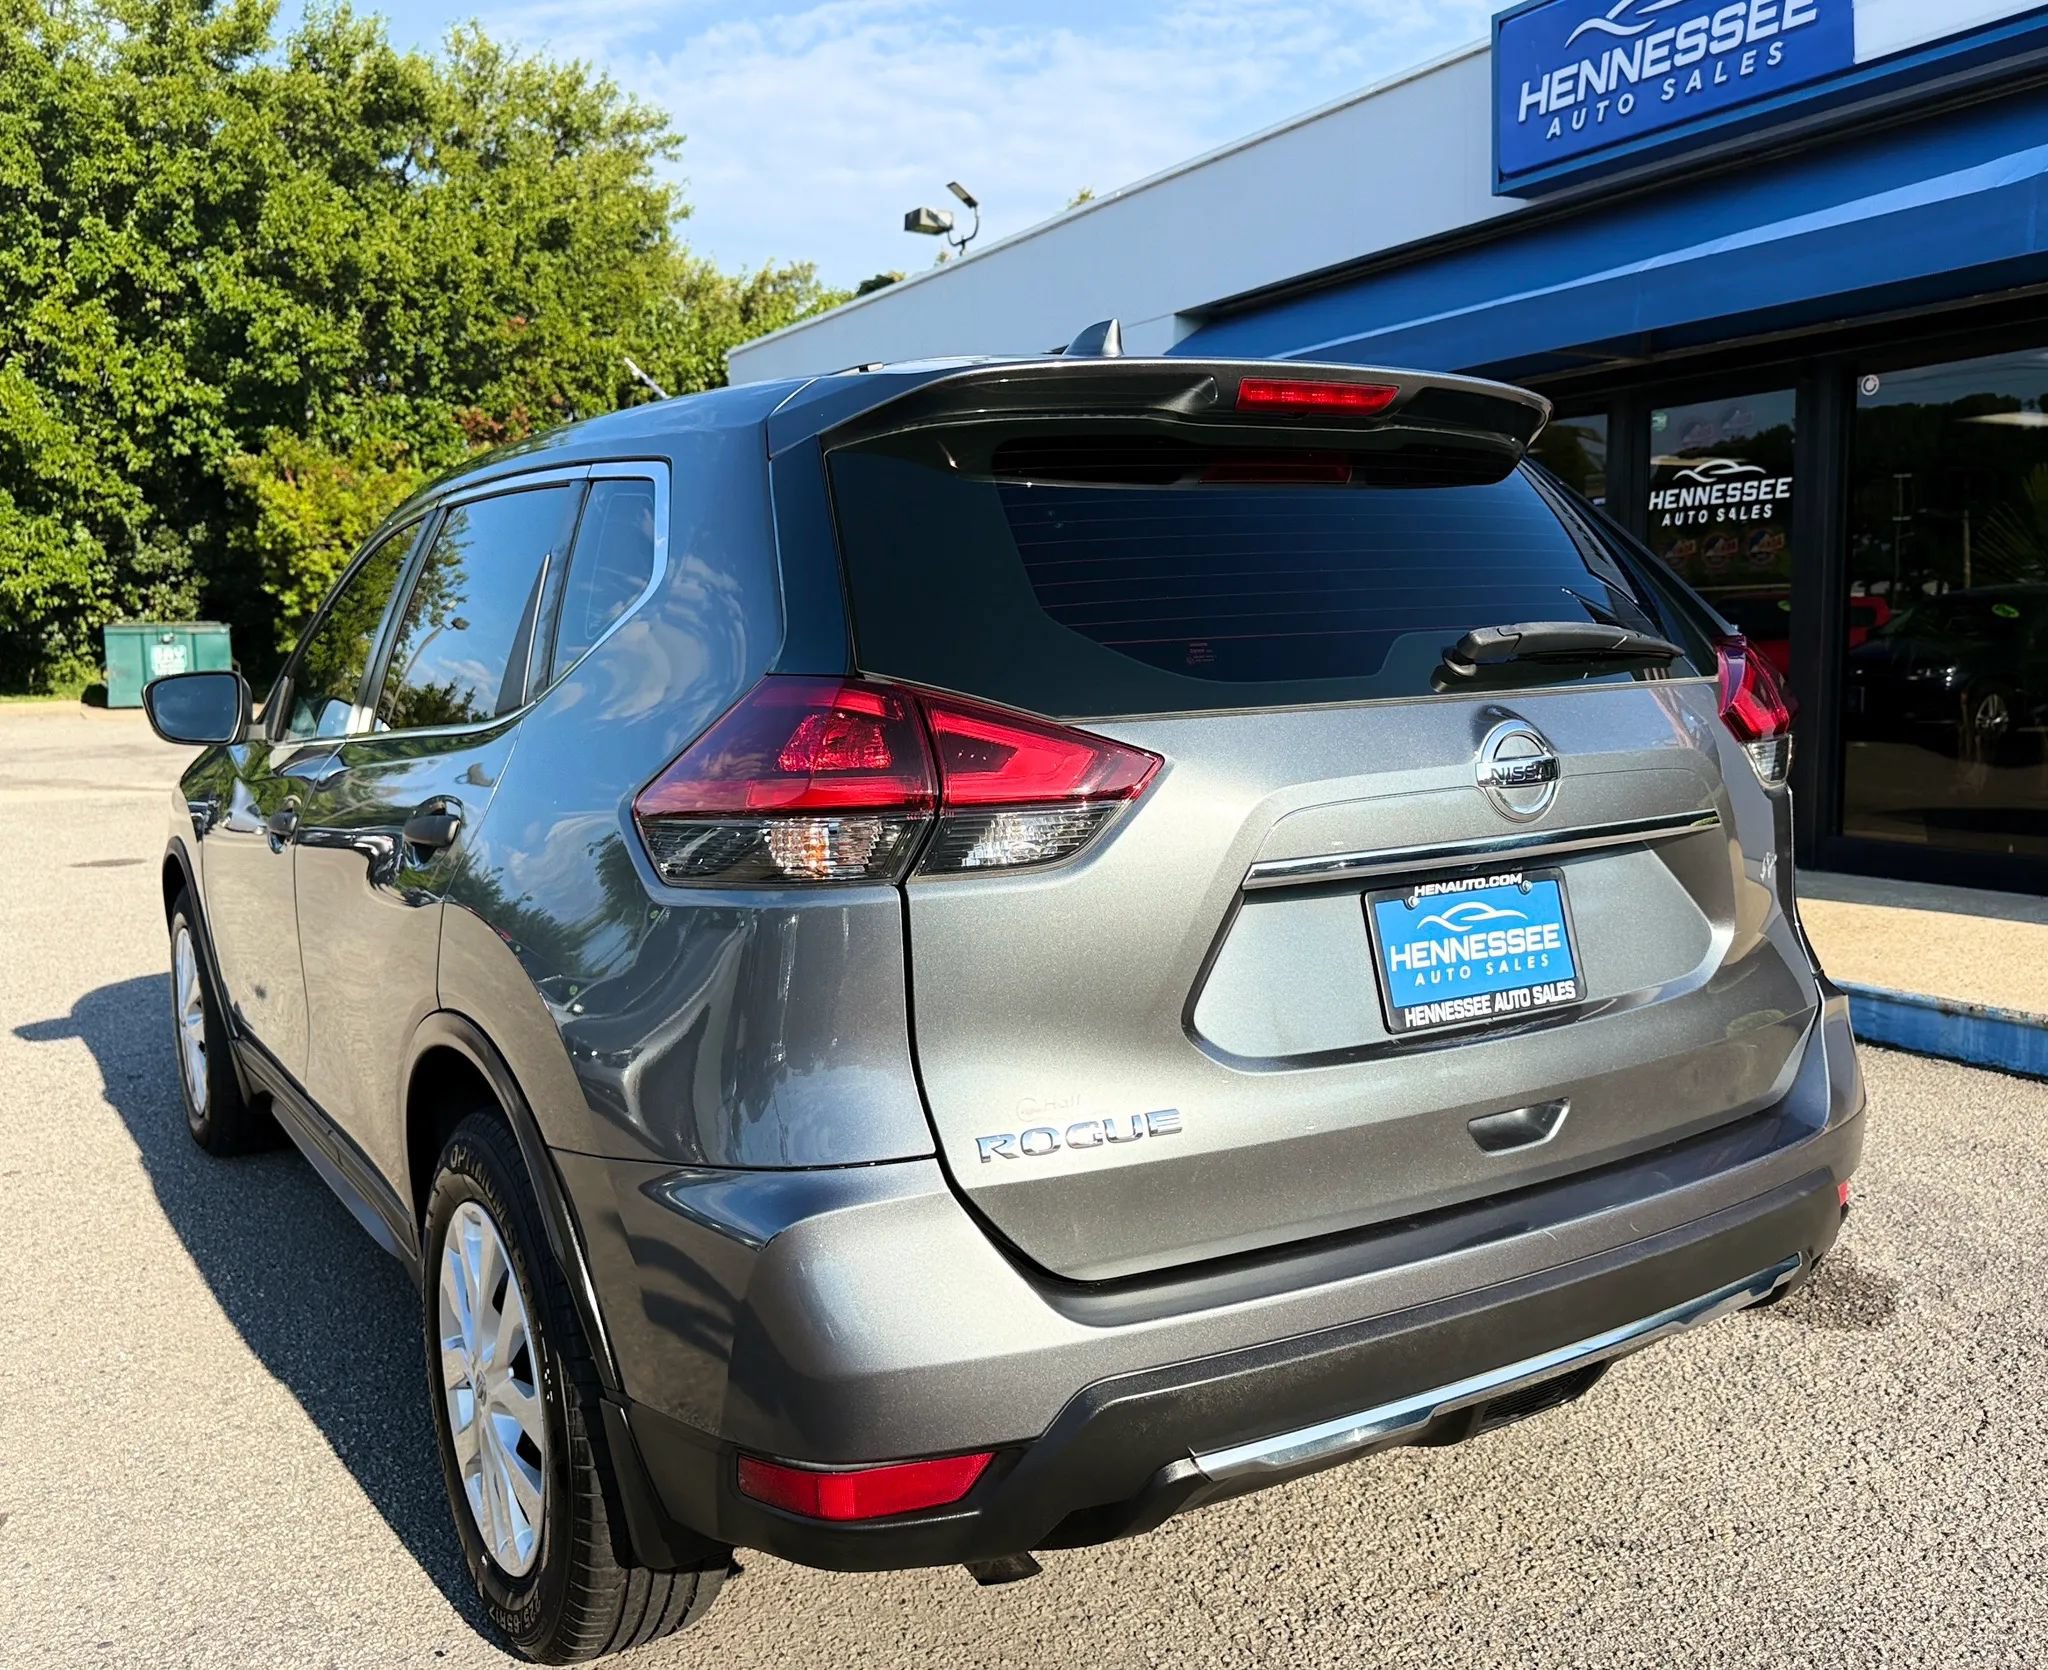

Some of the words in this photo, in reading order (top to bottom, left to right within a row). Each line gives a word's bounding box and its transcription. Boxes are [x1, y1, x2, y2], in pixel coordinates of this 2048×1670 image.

[1518, 0, 1817, 123] HENNESSEE
[1546, 92, 1635, 140] AUTO
[1660, 41, 1784, 102] SALES
[1648, 477, 1793, 511] HENNESSEE
[1661, 509, 1709, 527] AUTO
[1716, 503, 1773, 523] SALES
[1414, 872, 1523, 898] HENAUTO.COM
[1390, 922, 1562, 973] HENNESSEE
[1414, 964, 1472, 987] AUTO
[1485, 954, 1550, 976] SALES
[1404, 994, 1493, 1028] HENNESSEE
[1494, 988, 1531, 1013] AUTO
[1533, 980, 1577, 1006] SALES
[975, 1108, 1184, 1164] ROGUE
